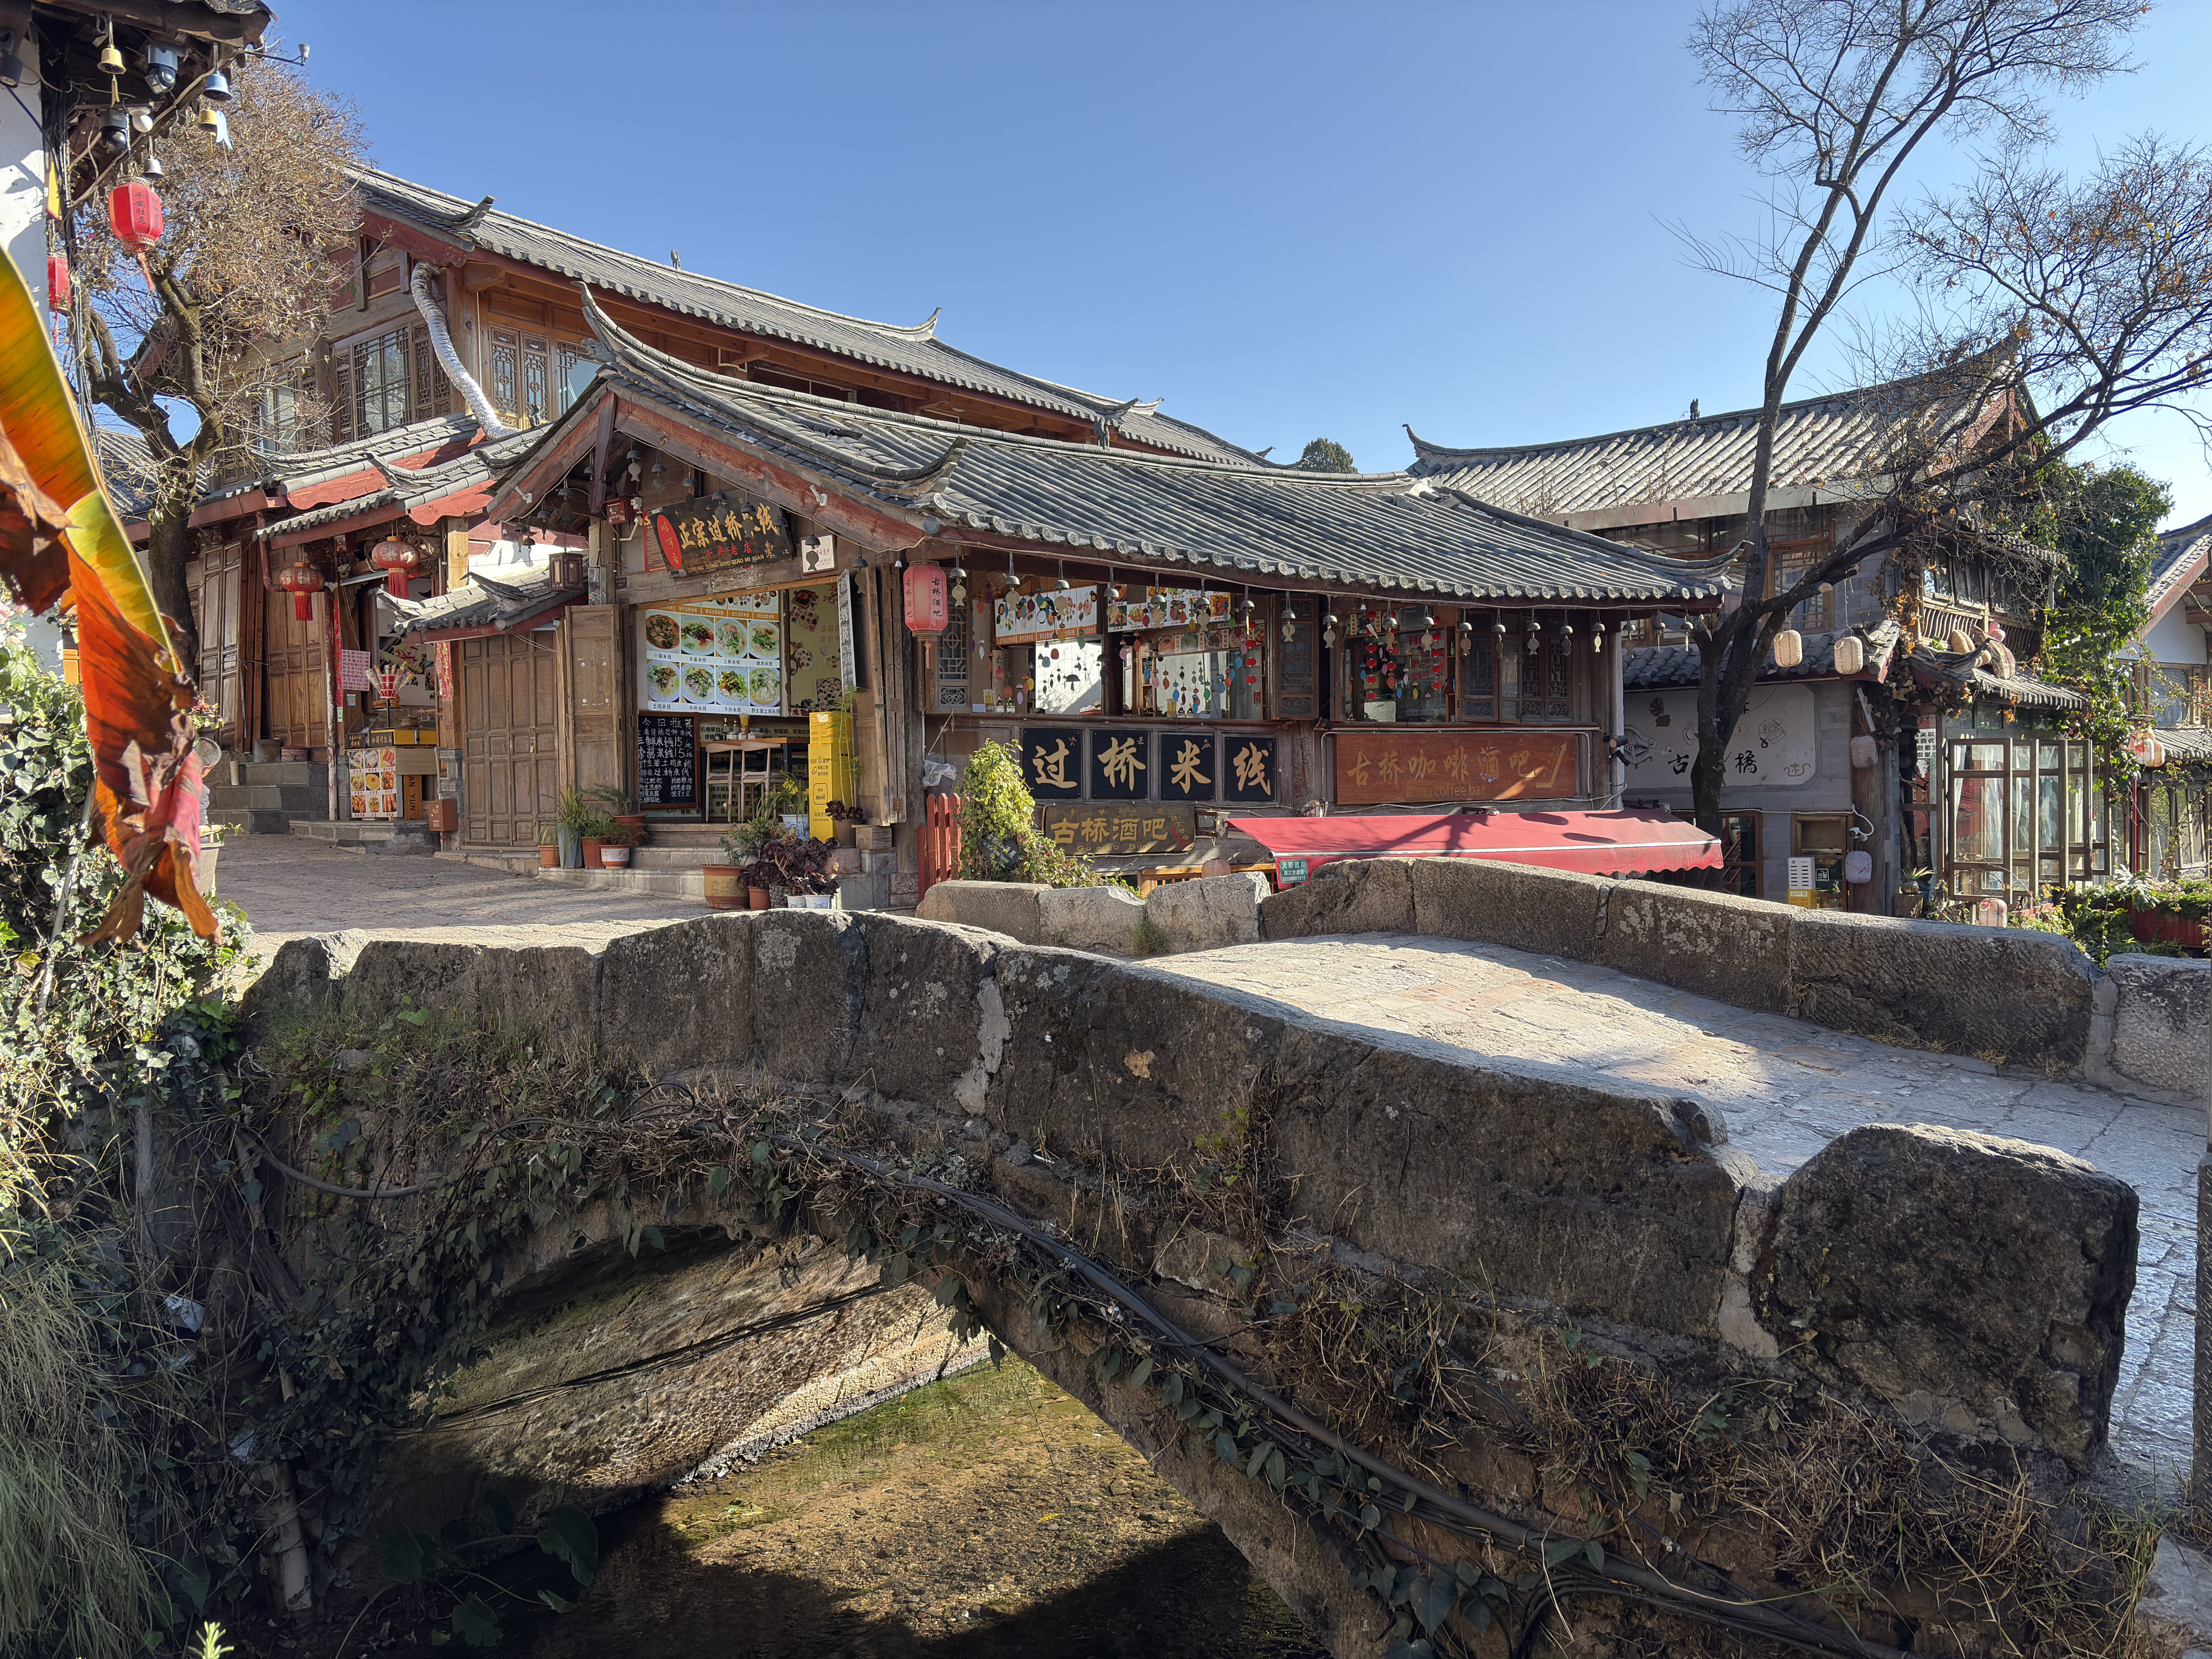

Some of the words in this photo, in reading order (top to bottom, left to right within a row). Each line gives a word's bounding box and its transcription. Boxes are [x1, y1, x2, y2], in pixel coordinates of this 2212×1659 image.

[706, 540, 752, 559] 十年老店
[932, 577, 942, 617] 古桥酒吧
[642, 717, 693, 729] 今日推荐
[1032, 737, 1271, 796] 过桥米线
[1347, 746, 1535, 786] 古桥咖啡酒吧
[1434, 783, 1467, 797] coffee
[1468, 783, 1485, 796] bar
[1051, 817, 1168, 844] 古桥酒吧
[1096, 844, 1119, 852] qiao
